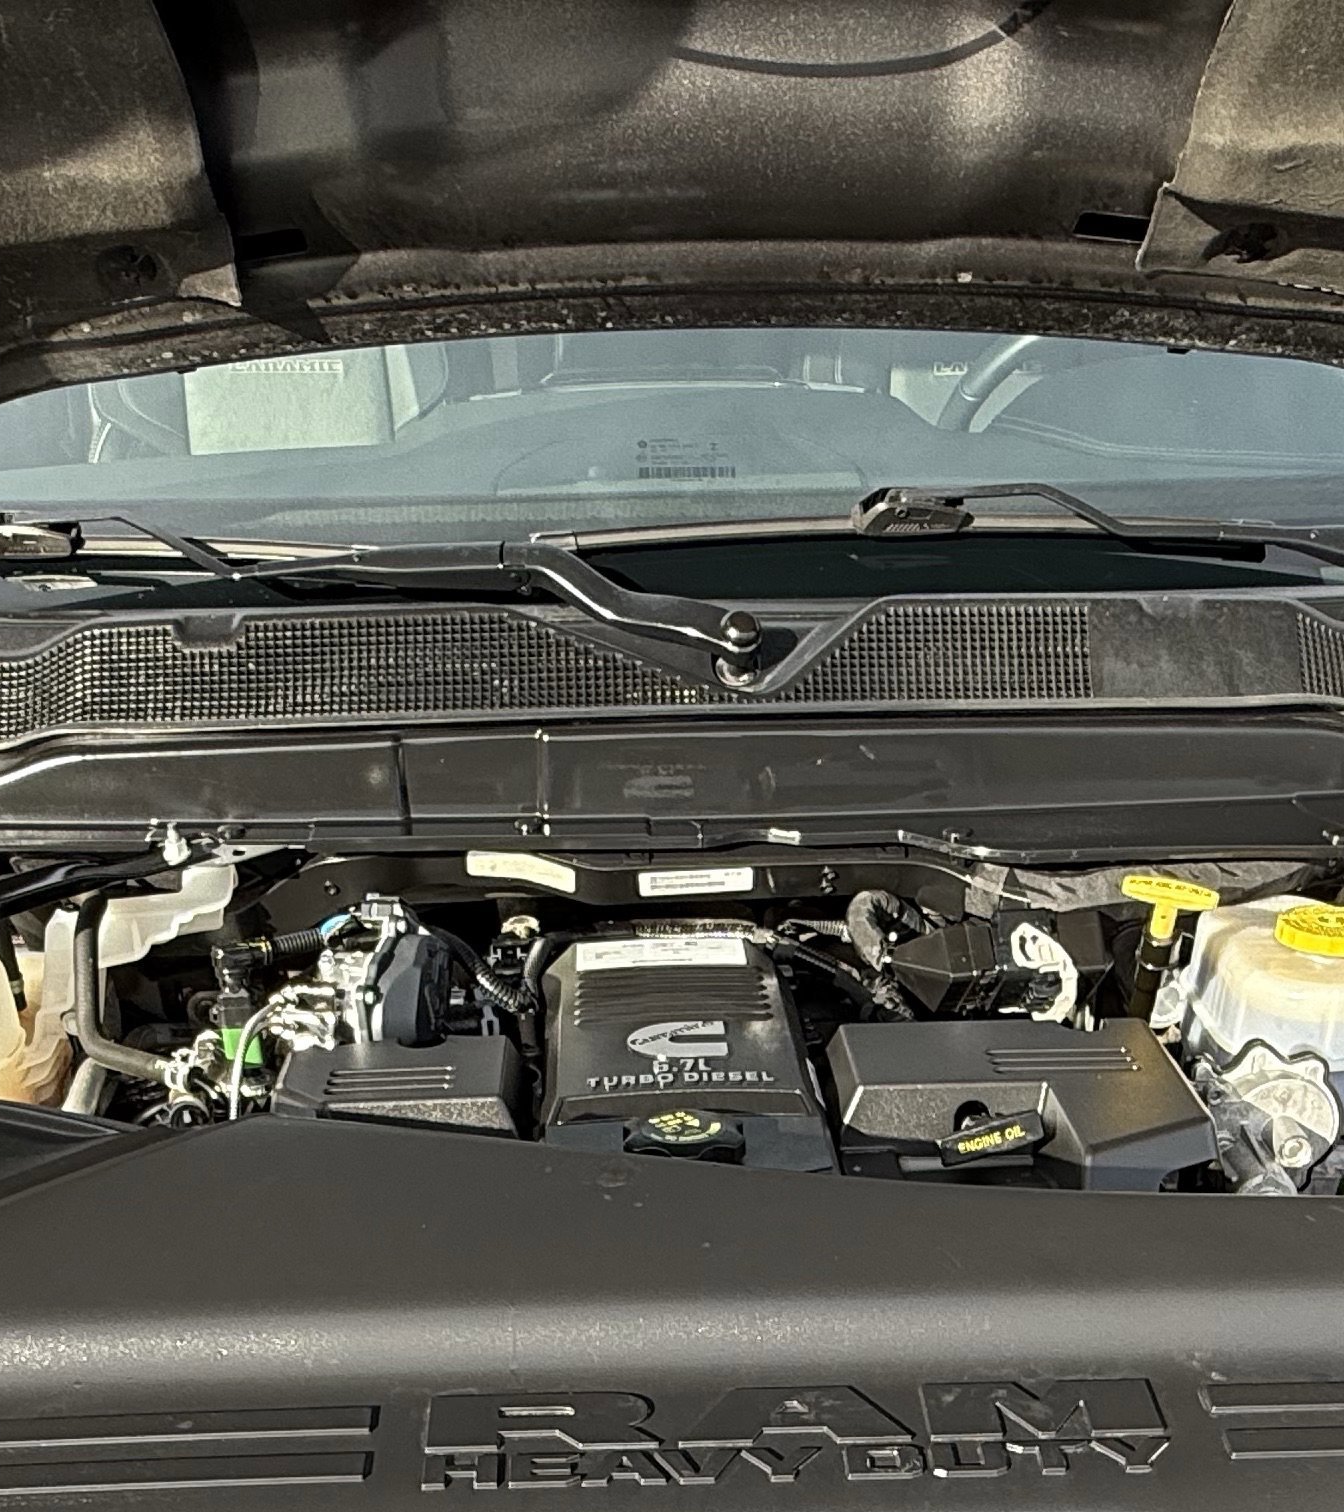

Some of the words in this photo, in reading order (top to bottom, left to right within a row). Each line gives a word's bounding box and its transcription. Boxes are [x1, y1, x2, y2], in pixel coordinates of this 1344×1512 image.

[229, 359, 342, 373] LARAMIE
[652, 1057, 712, 1073] 6.7L
[586, 1072, 675, 1090] TURBO
[683, 1070, 775, 1083] DIESEL
[957, 1131, 1002, 1154] ENGINE
[1004, 1125, 1026, 1140] OIL
[424, 1377, 1169, 1454] RAM
[420, 1446, 822, 1492] HEAVY
[841, 1437, 1171, 1481] DUTY
